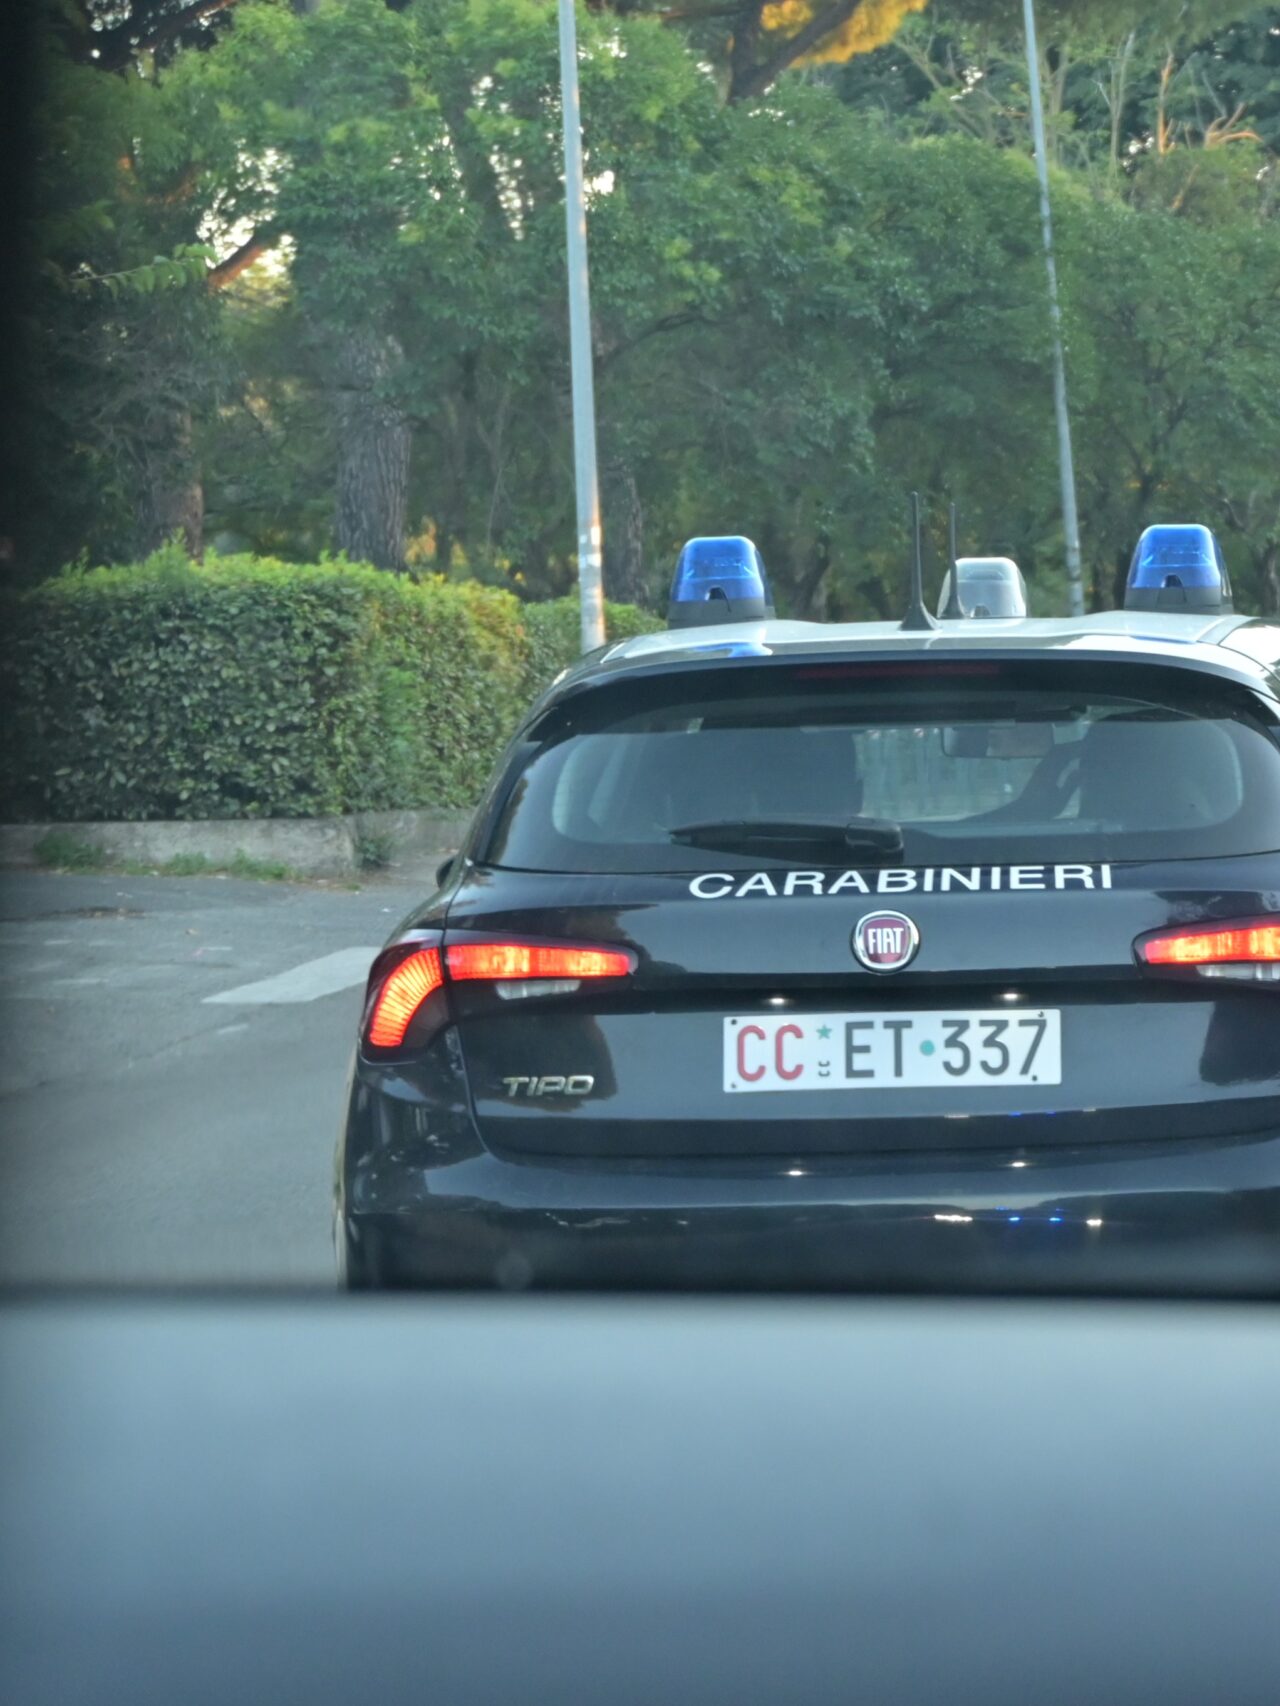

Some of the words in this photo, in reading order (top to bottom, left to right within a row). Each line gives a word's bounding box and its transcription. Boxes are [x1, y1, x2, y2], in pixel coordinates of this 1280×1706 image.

[689, 864, 1113, 900] CARABINIERI
[867, 927, 904, 955] FIAT
[736, 1024, 805, 1082] CC
[845, 1020, 913, 1079] ET
[941, 1018, 1048, 1077] 337
[503, 1075, 595, 1097] TIPO
